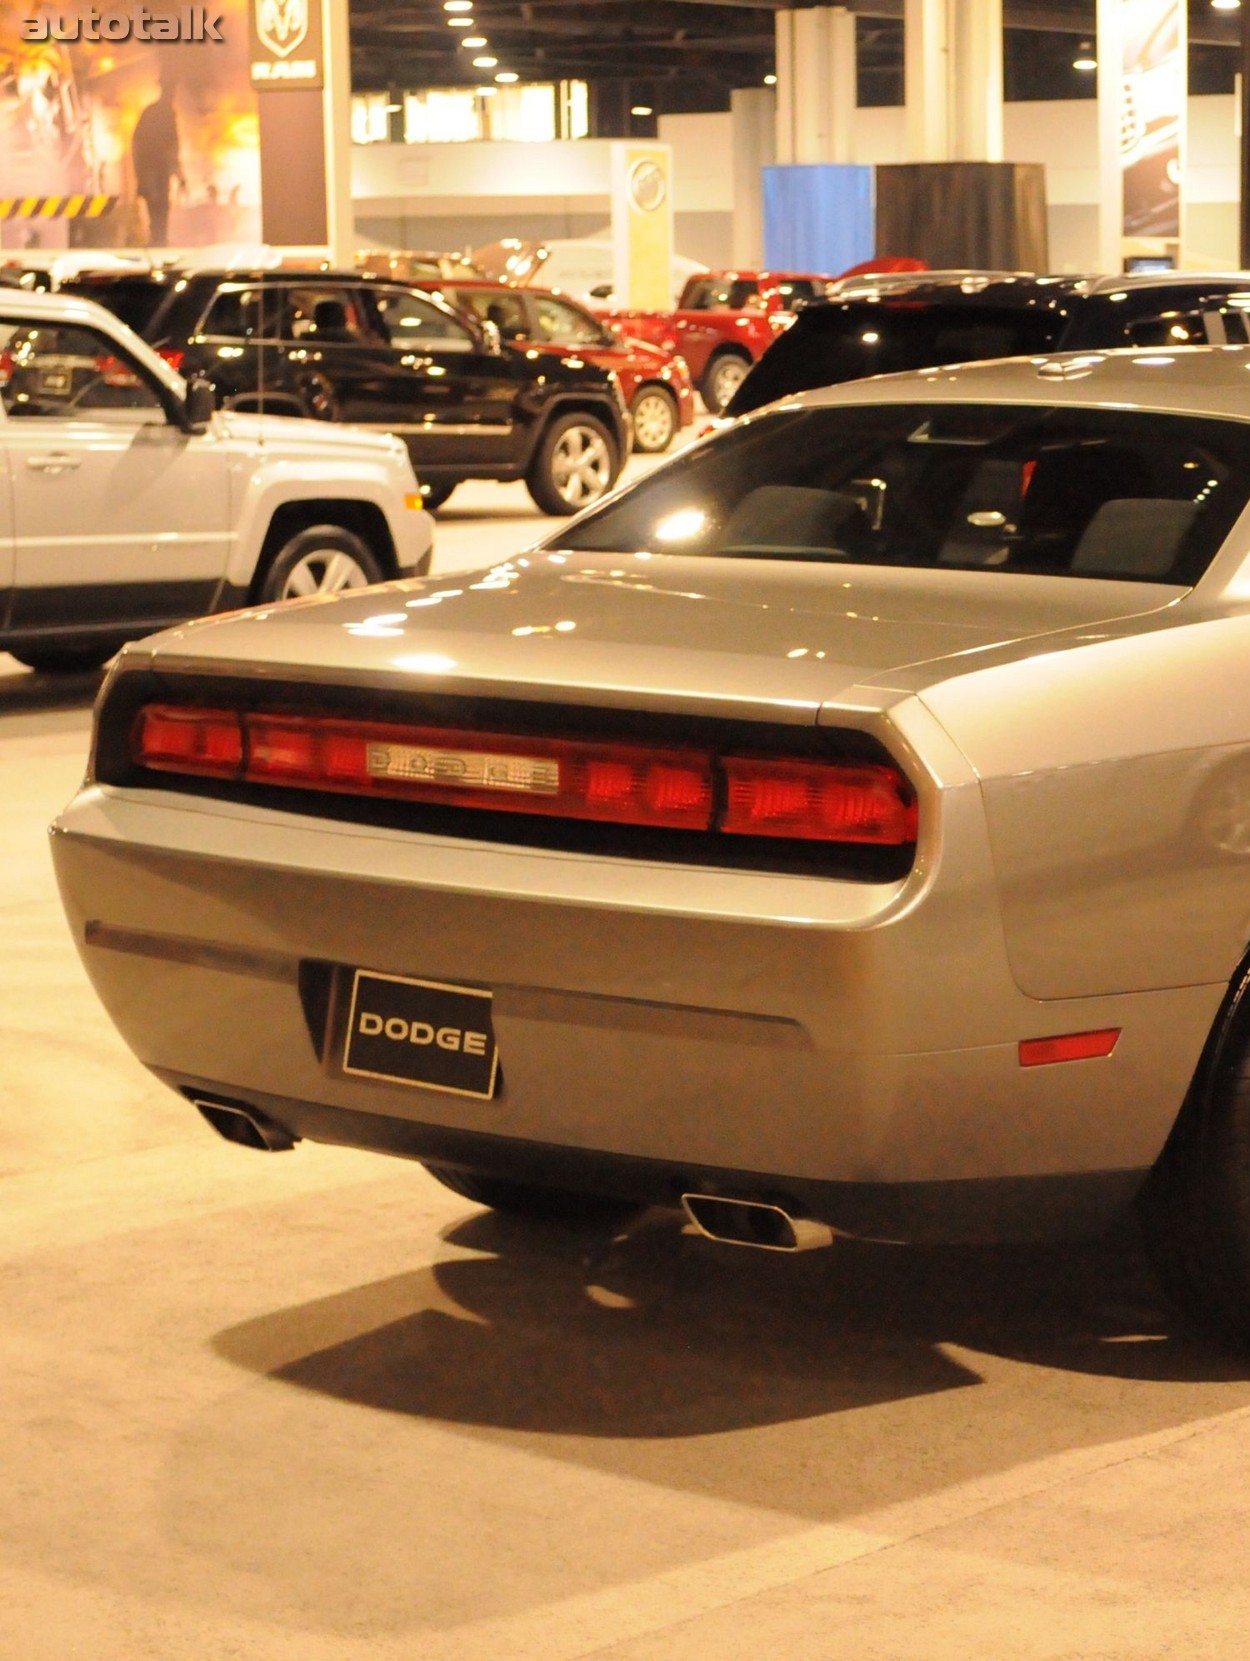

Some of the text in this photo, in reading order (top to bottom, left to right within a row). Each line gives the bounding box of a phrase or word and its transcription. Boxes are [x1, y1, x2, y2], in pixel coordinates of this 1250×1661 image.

[251, 60, 317, 80] RAM
[369, 750, 548, 785] DODGE
[358, 1011, 488, 1056] DODGE
